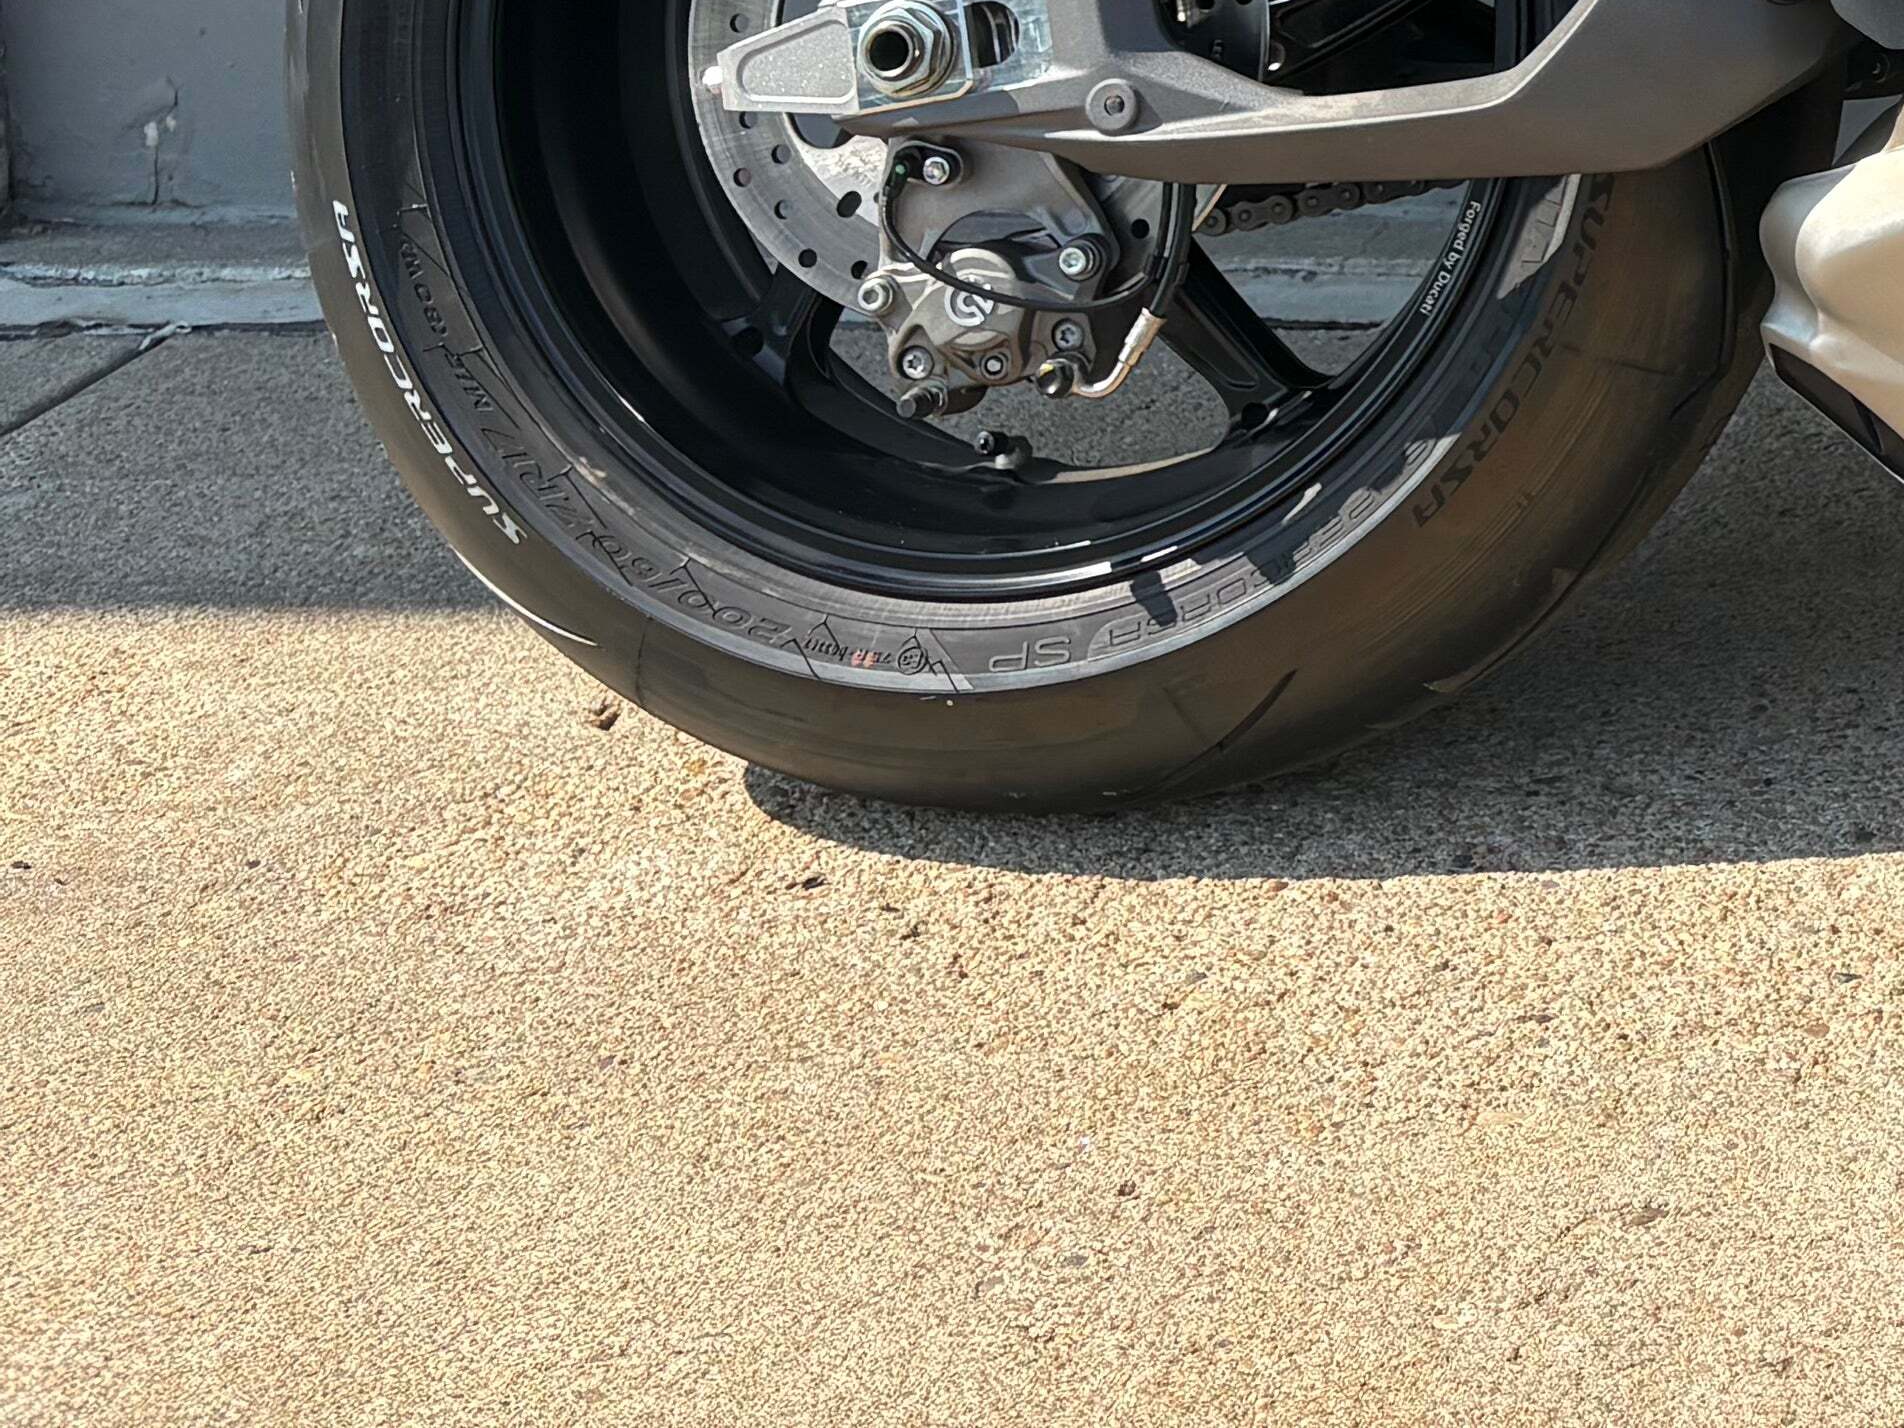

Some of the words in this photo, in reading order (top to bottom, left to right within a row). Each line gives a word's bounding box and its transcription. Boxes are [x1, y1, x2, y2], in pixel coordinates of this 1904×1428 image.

[1453, 200, 1481, 251] Forged
[1443, 251, 1461, 270] by
[1420, 271, 1451, 316] Ducati
[332, 199, 528, 545] SUPERCORSA
[988, 635, 1072, 672] SP
